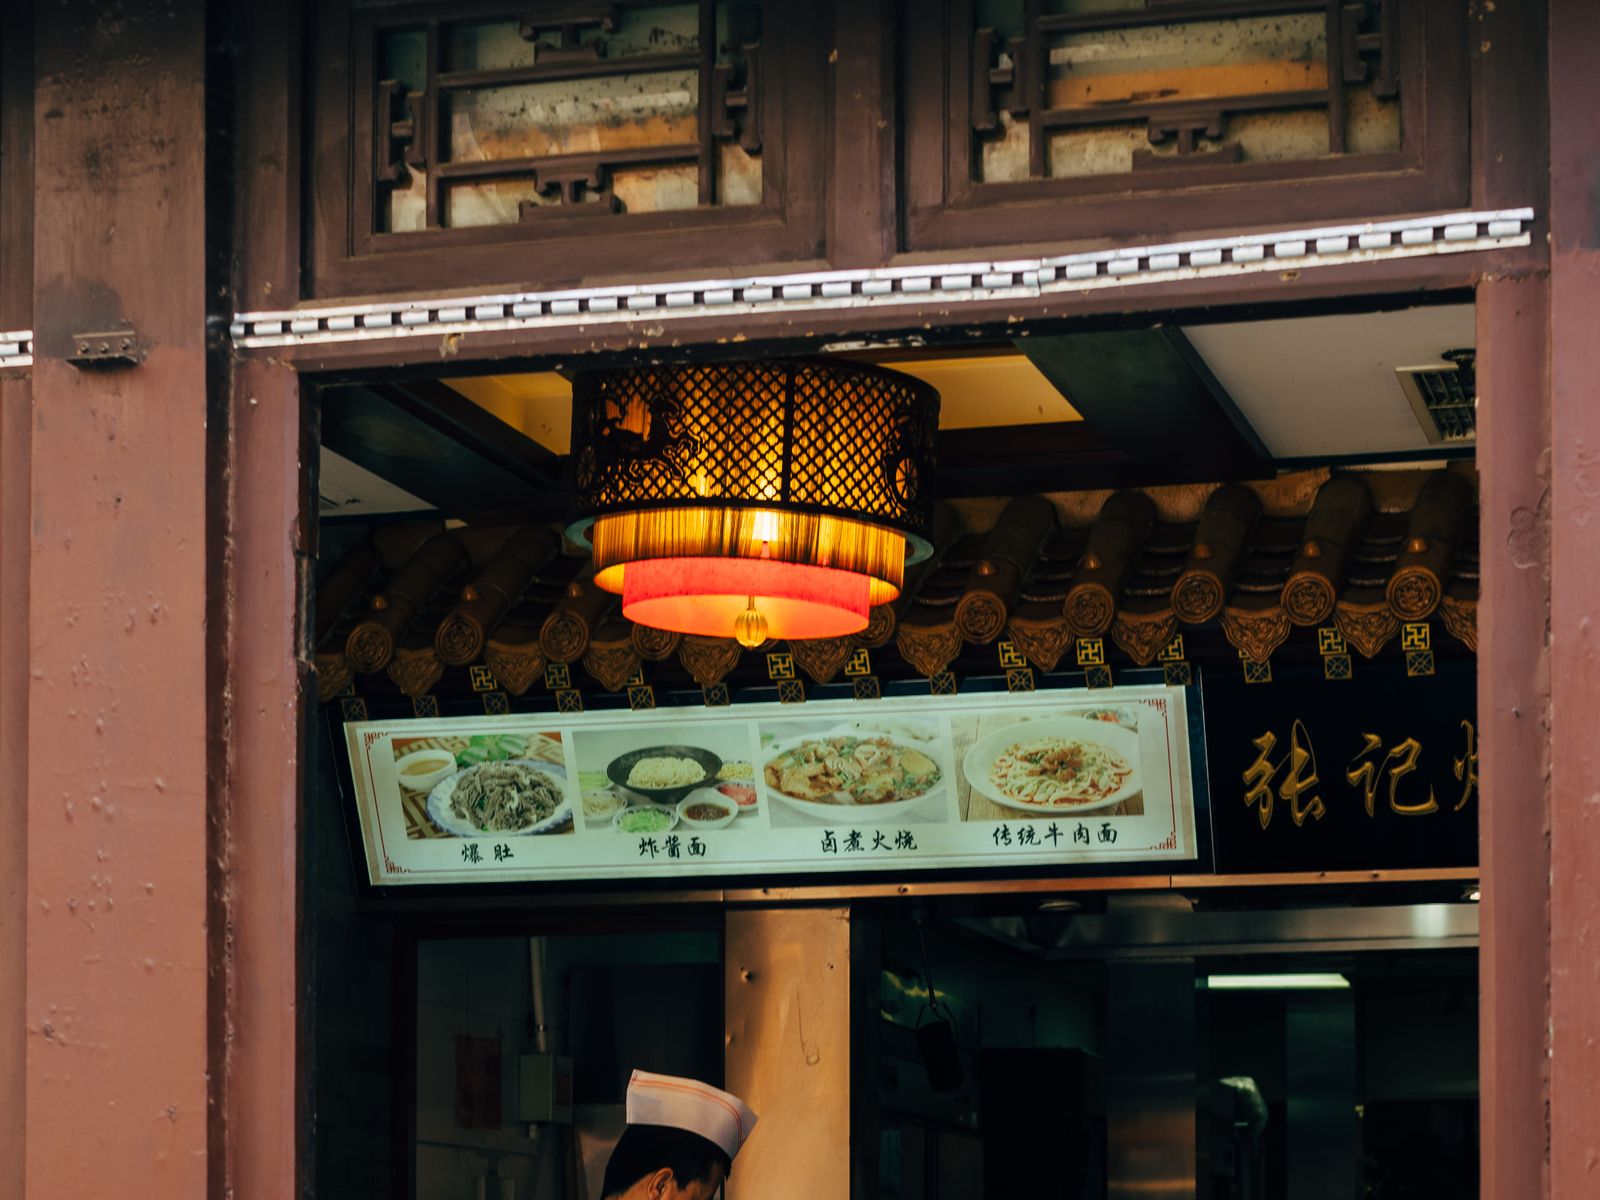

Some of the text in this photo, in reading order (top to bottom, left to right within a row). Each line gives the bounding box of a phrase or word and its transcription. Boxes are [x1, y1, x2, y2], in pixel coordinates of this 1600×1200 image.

[638, 835, 707, 860] 炸酱面
[820, 829, 918, 855] 卤煮火烧
[992, 821, 1119, 849] 传统牛肉面
[461, 842, 515, 864] 爆肚
